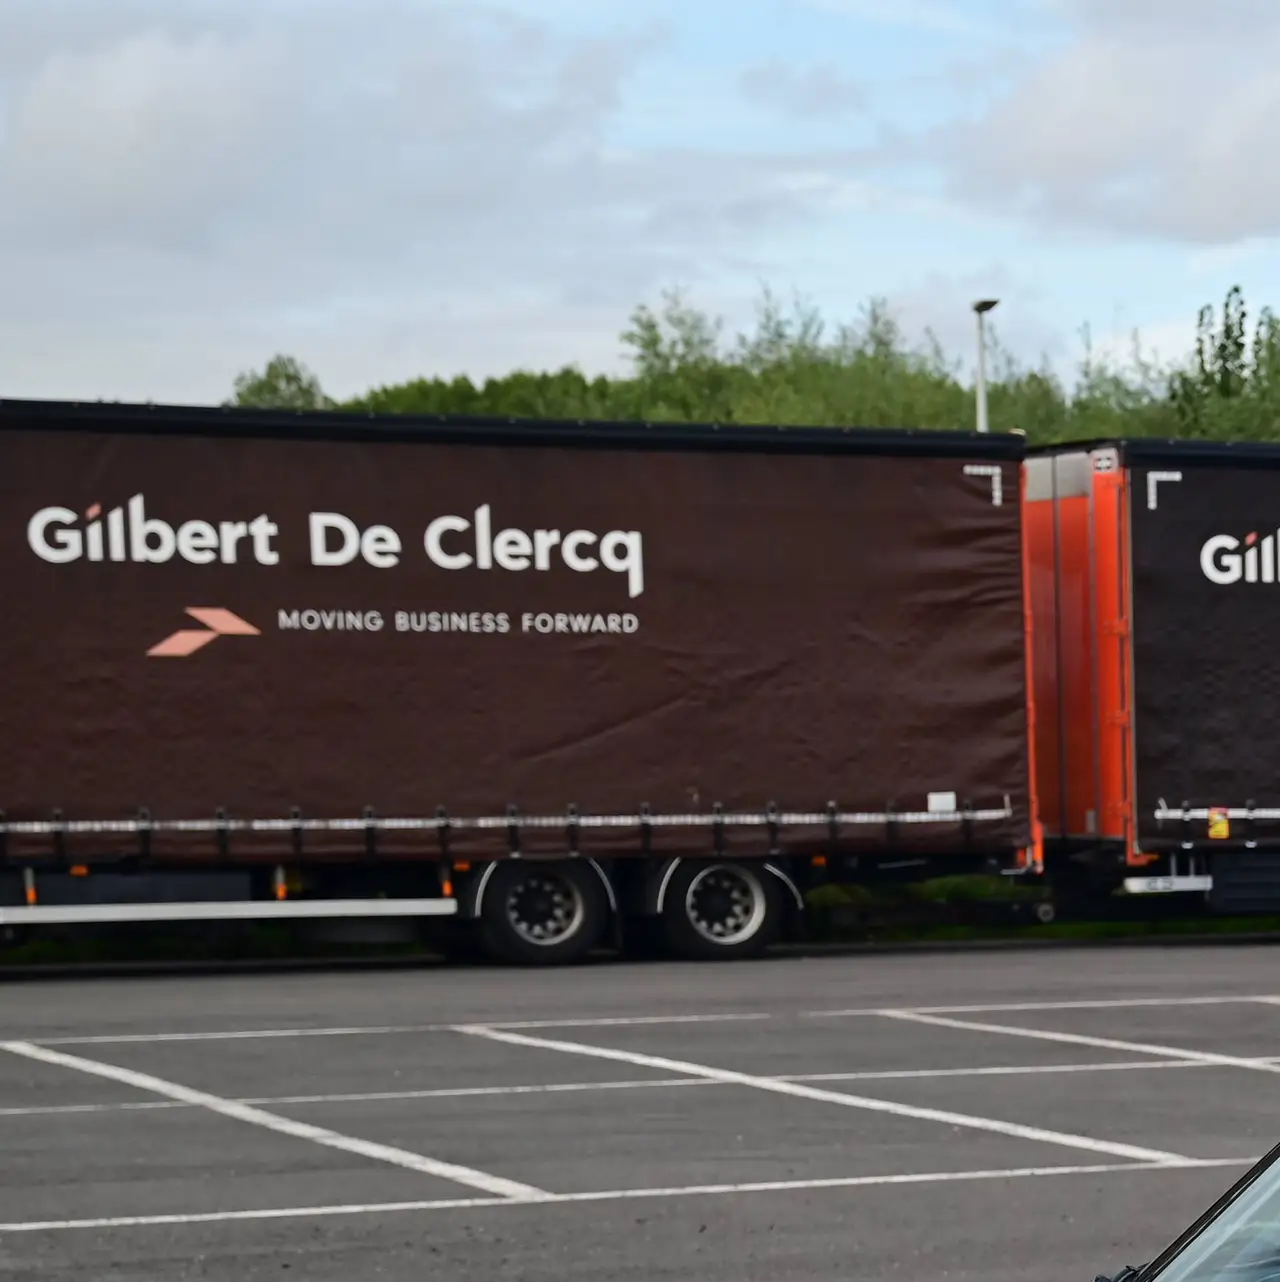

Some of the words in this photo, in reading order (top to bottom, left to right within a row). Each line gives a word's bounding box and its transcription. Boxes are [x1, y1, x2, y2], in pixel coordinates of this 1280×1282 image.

[27, 493, 279, 566] Gilbert
[309, 511, 403, 568] De
[424, 503, 645, 599] Clercq
[278, 609, 384, 632] MOVING
[394, 611, 511, 634] BUSINESS
[521, 612, 640, 634] FORWARD
